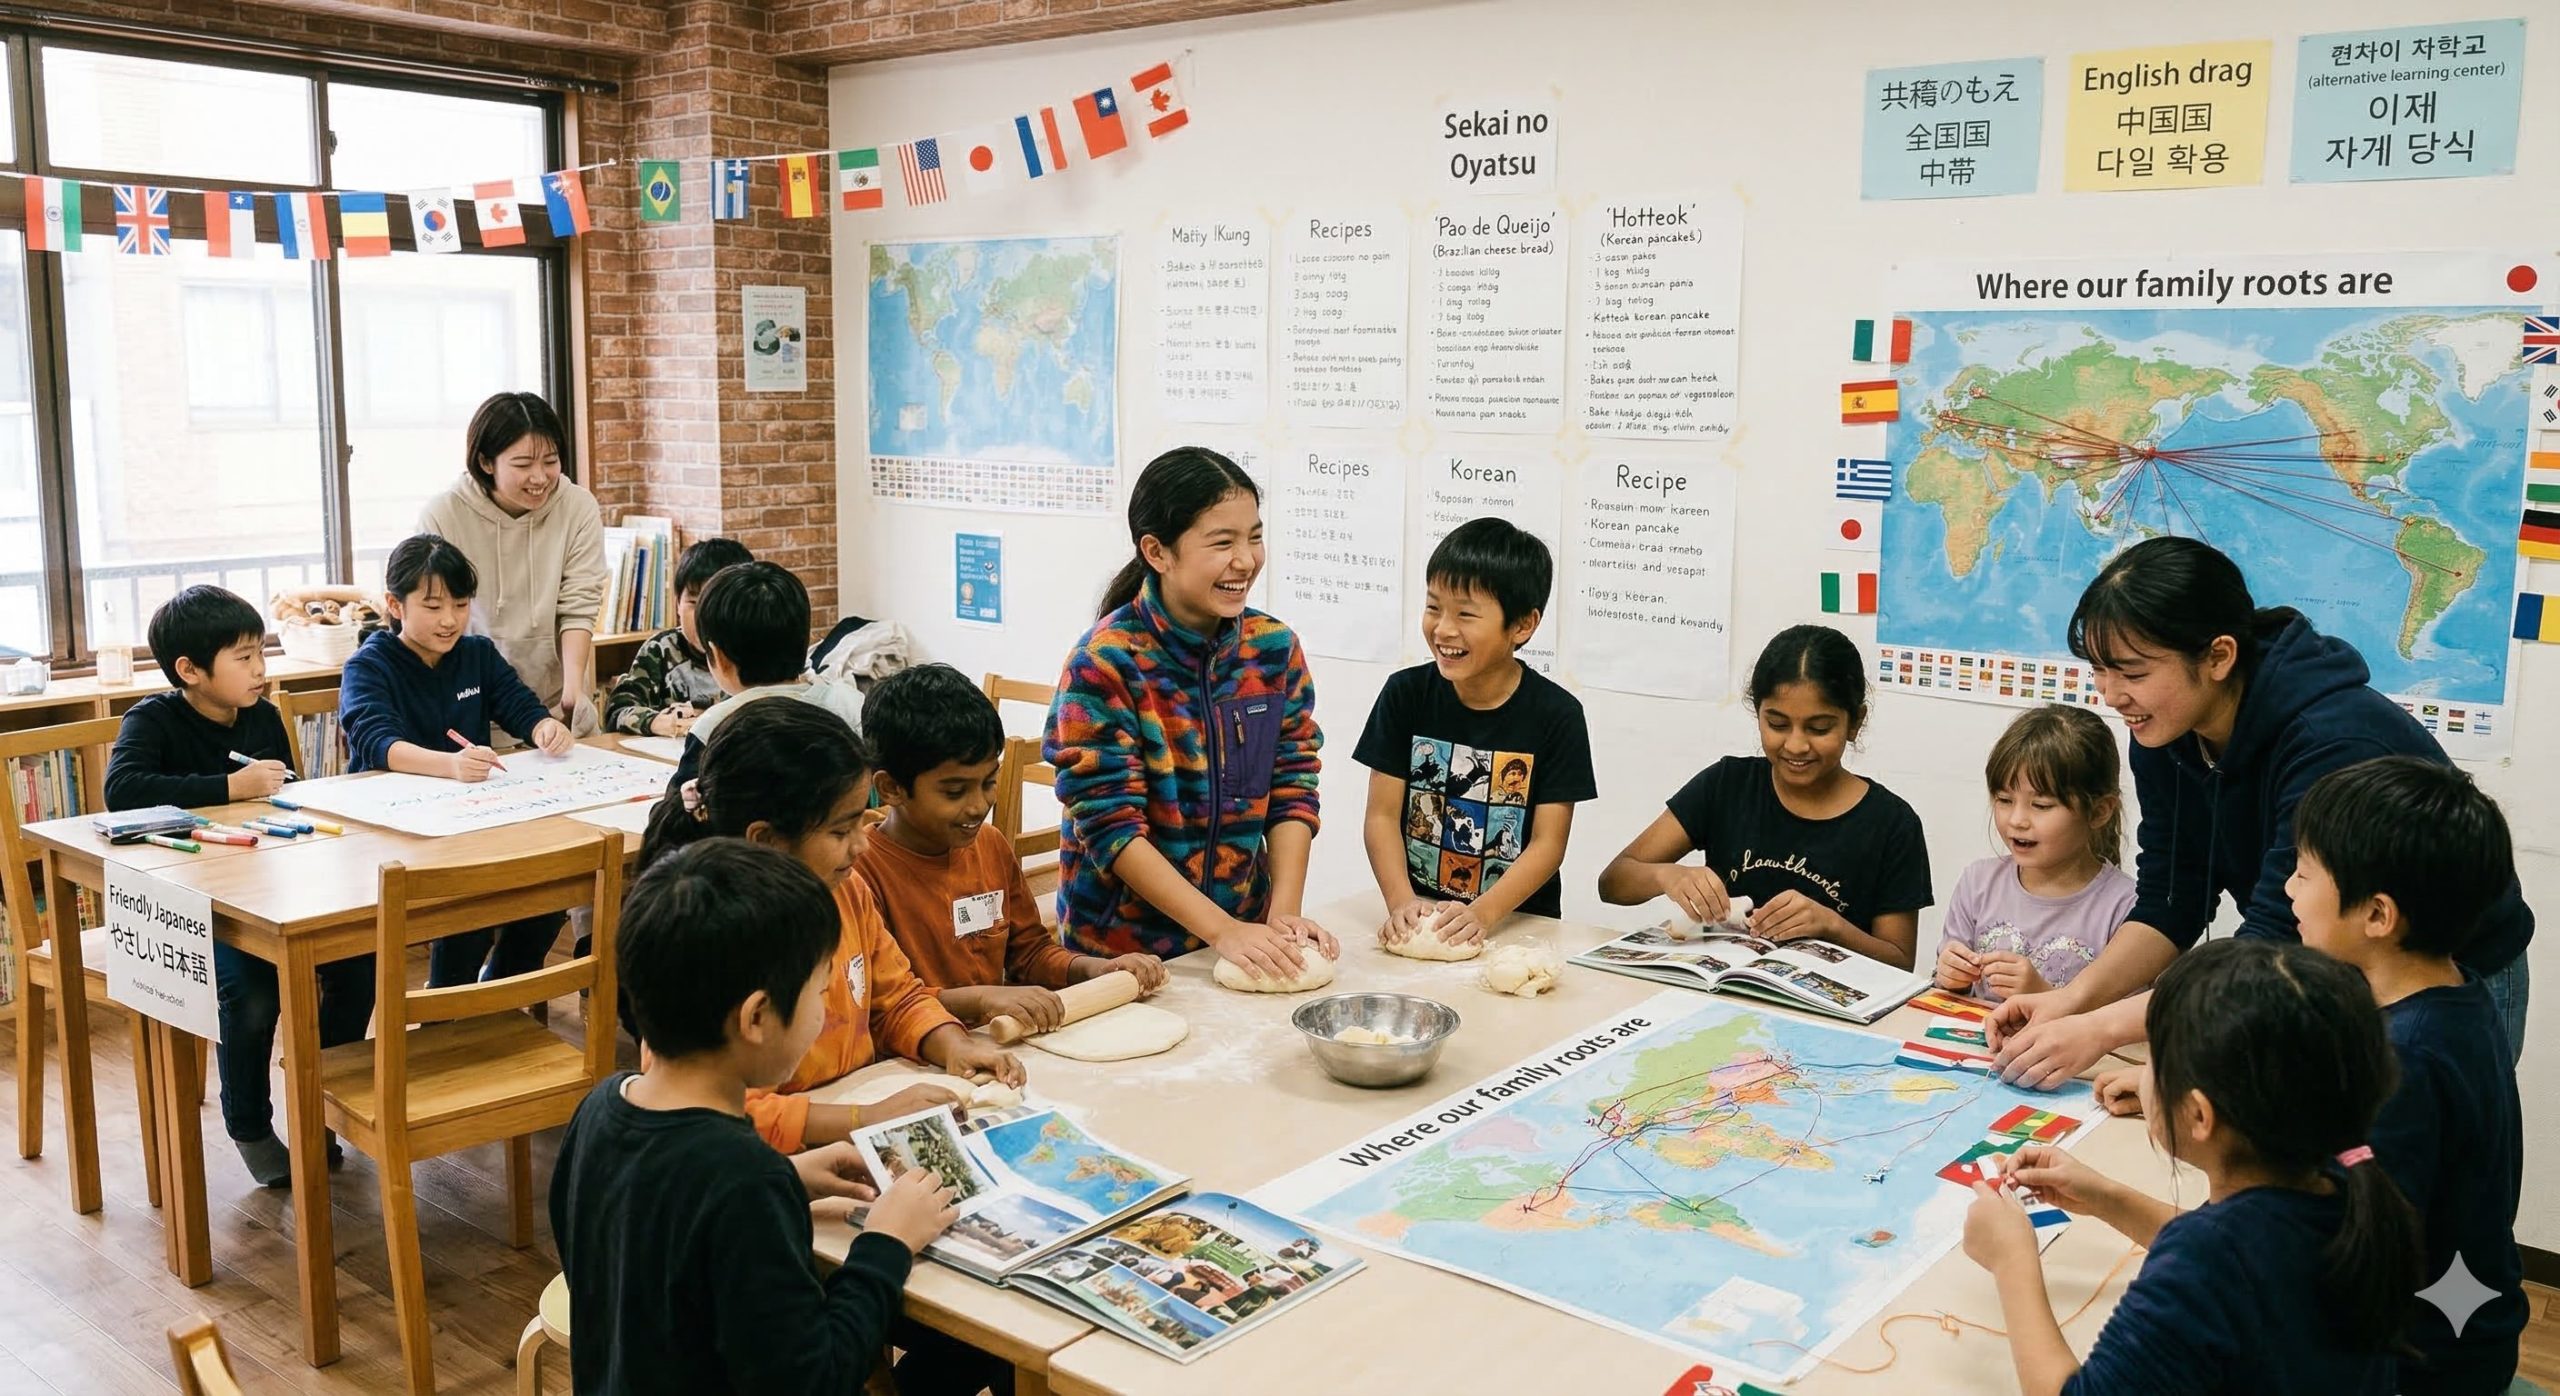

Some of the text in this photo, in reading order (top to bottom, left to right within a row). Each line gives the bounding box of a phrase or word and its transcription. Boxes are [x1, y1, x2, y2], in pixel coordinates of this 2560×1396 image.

[2084, 58, 2253, 95] English drag
[2308, 61, 2505, 89] (alternative learning center)
[2117, 102, 2212, 136] 中国国
[2369, 90, 2437, 126] 이제
[1444, 109, 1548, 139] Sekai no
[1906, 120, 1991, 151] 全国国
[2097, 146, 2154, 178] 다일
[2325, 129, 2474, 169] 자게 당식
[1450, 152, 1536, 185] Oyatsu
[1434, 211, 1556, 239] 'Pao de Queijo'
[1606, 203, 1696, 228] 'Hotteok'
[1310, 218, 1372, 245] Recipes
[1600, 228, 1702, 248] (Korean pancakes)
[1484, 243, 1517, 256] cheese
[1520, 240, 1554, 256] bread)
[1976, 268, 2393, 305] Where our family roots are
[1670, 309, 1710, 324] pancake
[1309, 453, 1370, 480] Recipes
[1450, 457, 1517, 483] Korean
[1616, 463, 1687, 499] Recipe
[1590, 518, 1680, 535] Korean pancake
[1642, 562, 1662, 573] and
[109, 884, 207, 938] Friendly Japanese
[110, 921, 209, 986] やさしい日本語
[1339, 1016, 1652, 1169] Where our family roots are
